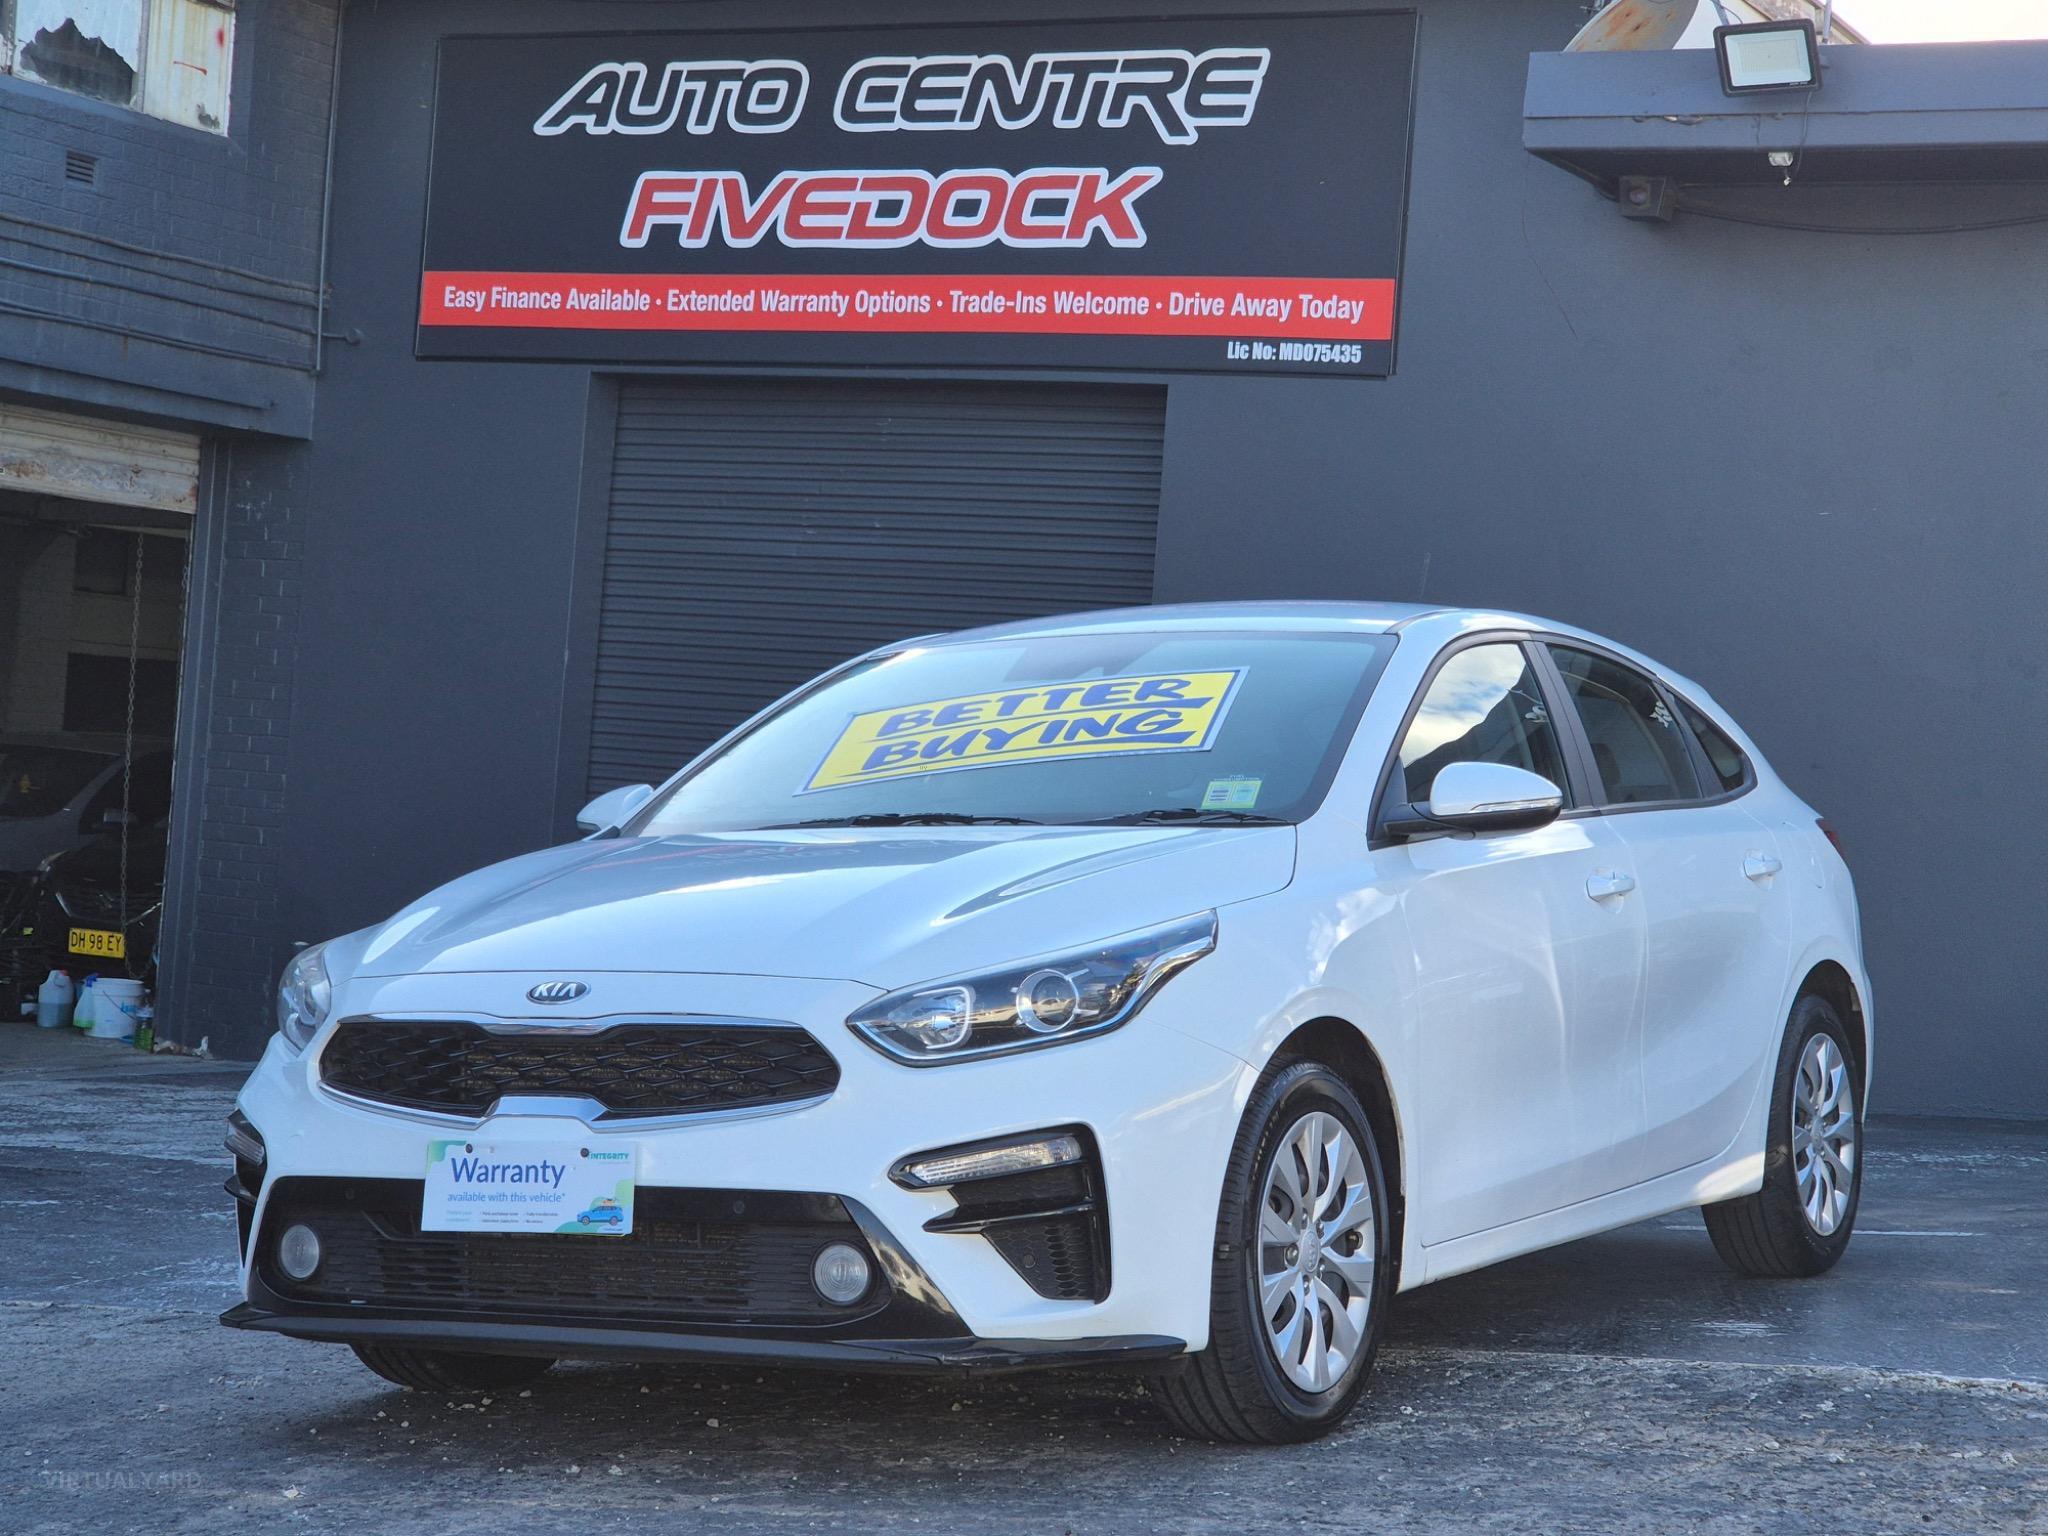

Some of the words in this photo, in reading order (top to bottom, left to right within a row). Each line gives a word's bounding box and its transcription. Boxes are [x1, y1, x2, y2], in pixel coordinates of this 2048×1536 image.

[533, 59, 810, 136] AUTO
[833, 48, 1271, 145] CENTRE
[620, 167, 1163, 248] FIVEDOCK
[444, 286, 486, 312] Easy
[491, 287, 561, 310] Finance
[566, 288, 650, 311] Available
[667, 289, 755, 312] Extended
[761, 289, 850, 317] Warranty
[854, 290, 931, 318] Options
[950, 290, 1047, 314] Trade-Ins
[1053, 291, 1149, 316] Welcome
[1169, 292, 1225, 316] Drive
[1230, 293, 1292, 322] Away
[1299, 294, 1364, 324] Today
[1227, 341, 1249, 360] Lic
[1252, 342, 1276, 361] No:
[1279, 342, 1362, 364] MD075435
[876, 678, 1192, 738] BETTER
[861, 709, 1185, 771] BUYING
[71, 931, 86, 948] DH
[89, 934, 103, 951] 98
[107, 935, 122, 952] EY
[533, 982, 578, 998] KIA
[590, 1152, 629, 1160] INTEGRITY
[451, 1157, 566, 1189] Warranty
[447, 1192, 487, 1203] available
[487, 1192, 509, 1203] with
[510, 1193, 527, 1203] this
